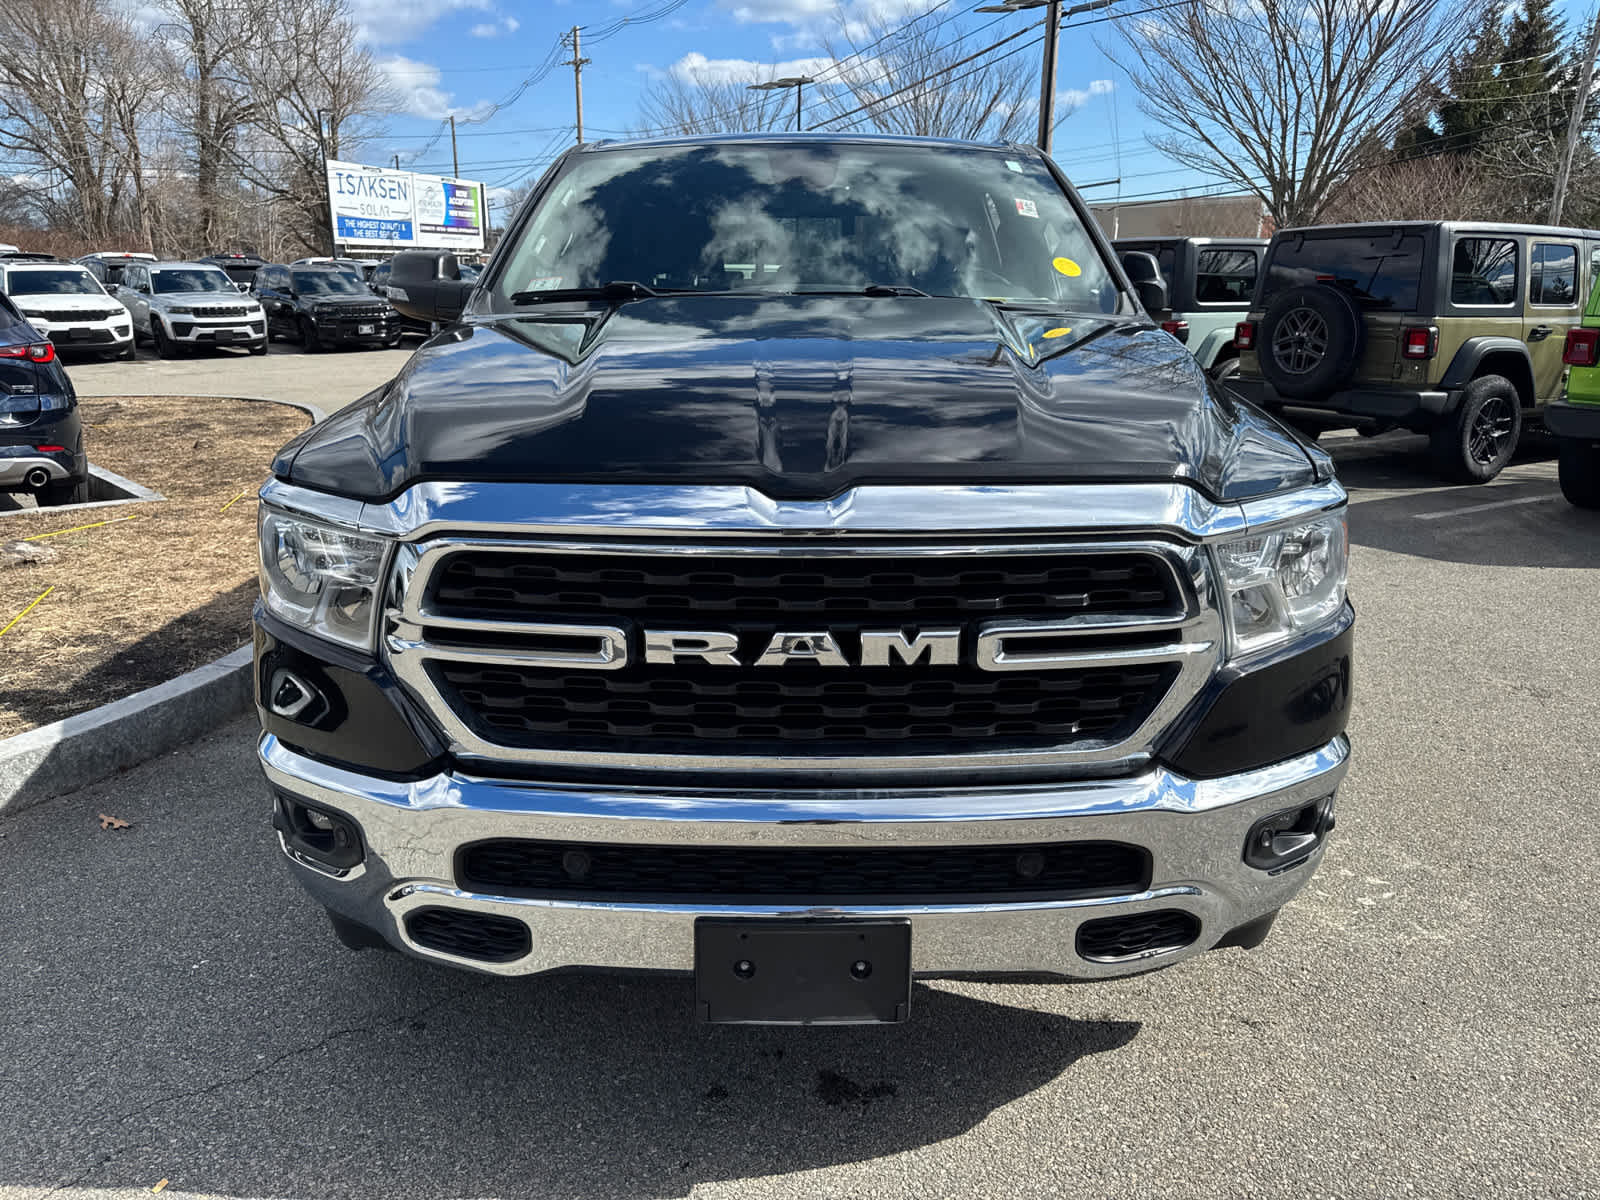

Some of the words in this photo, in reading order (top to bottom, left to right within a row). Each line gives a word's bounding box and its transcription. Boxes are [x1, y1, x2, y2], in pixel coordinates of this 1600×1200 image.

[336, 172, 407, 200] ISAKSEN
[359, 203, 391, 217] SOLAR
[344, 219, 356, 228] THE
[644, 629, 961, 667] RAM
